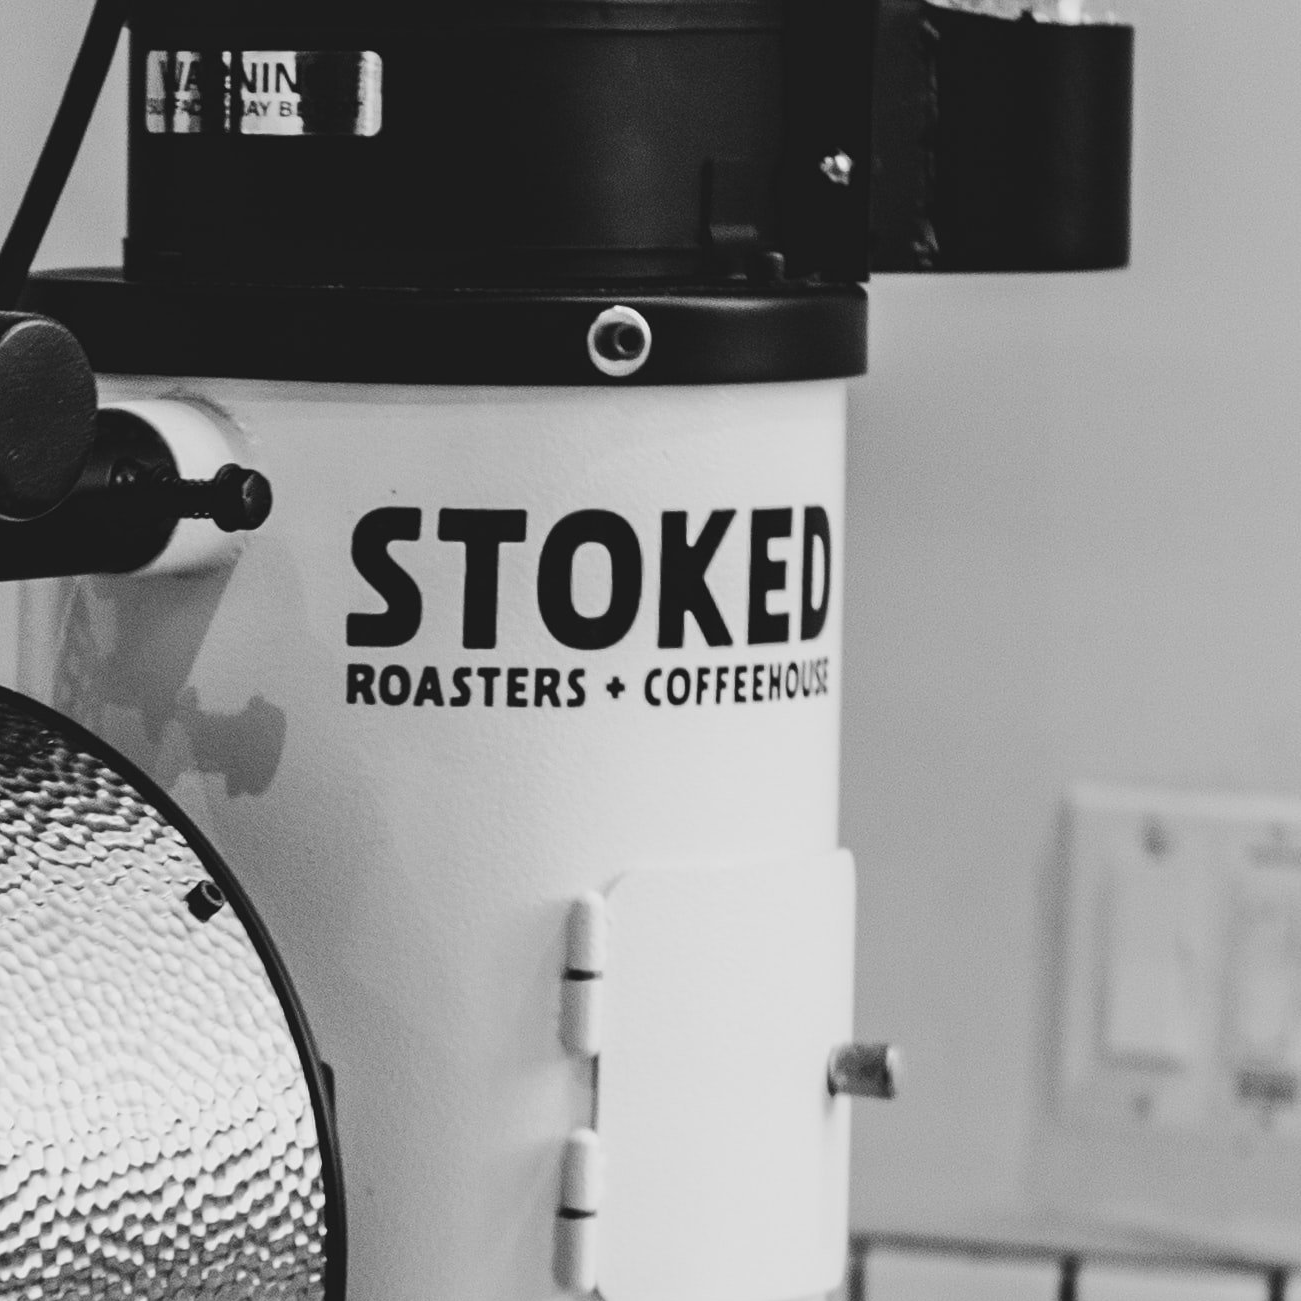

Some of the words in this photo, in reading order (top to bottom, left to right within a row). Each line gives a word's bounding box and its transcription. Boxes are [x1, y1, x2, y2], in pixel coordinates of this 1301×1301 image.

[228, 100, 271, 117] AY
[346, 505, 831, 650] STOKED
[346, 664, 586, 708] ROASTERS
[606, 677, 626, 699] +
[644, 657, 828, 707] COFFEEHOUSE
